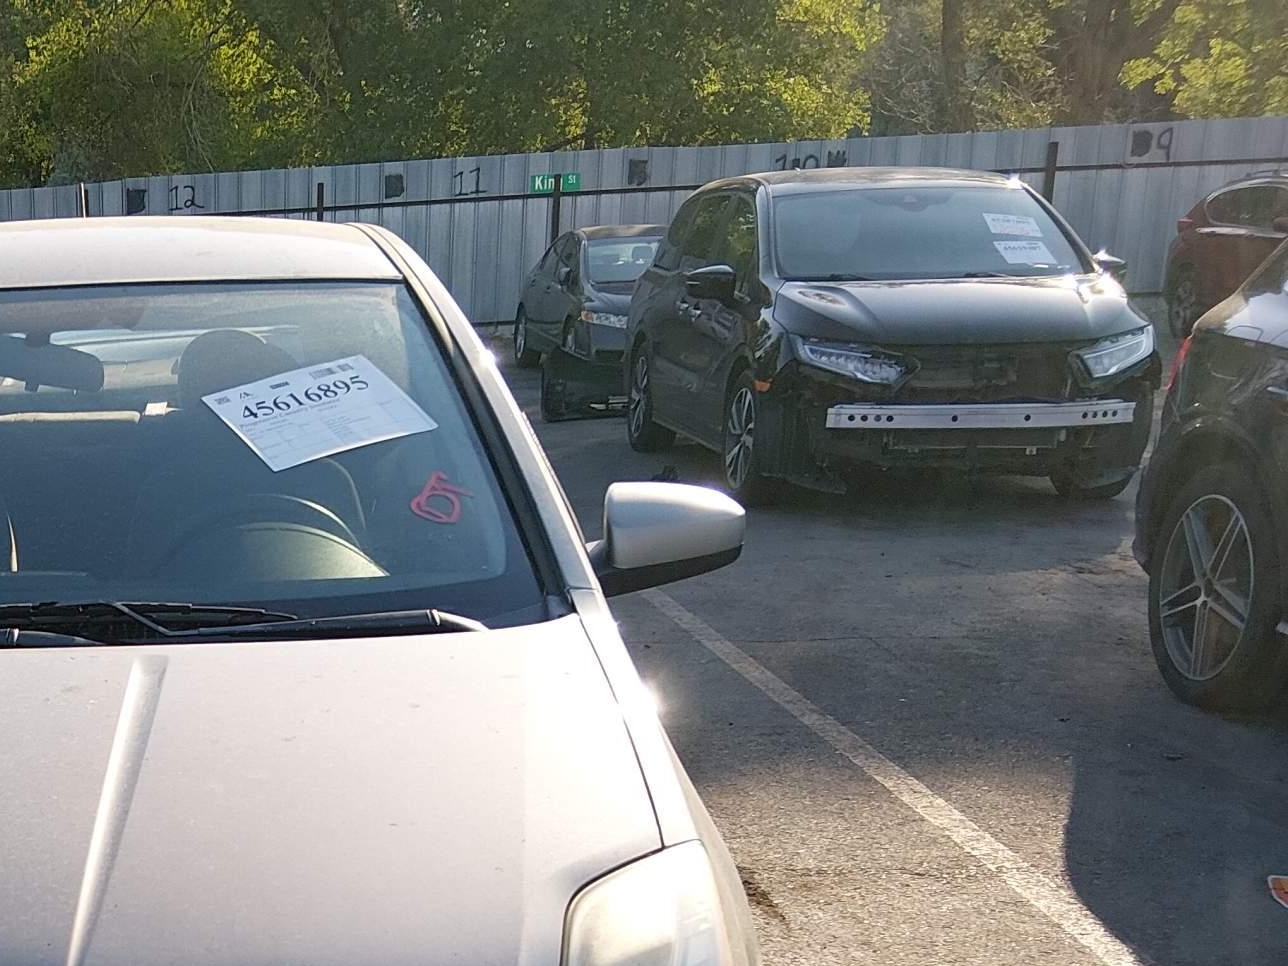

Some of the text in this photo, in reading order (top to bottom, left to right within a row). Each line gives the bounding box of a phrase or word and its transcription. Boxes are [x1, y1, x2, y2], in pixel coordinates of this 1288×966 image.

[453, 167, 487, 197] 11
[168, 185, 205, 211] 12
[242, 375, 369, 419] 45616895
